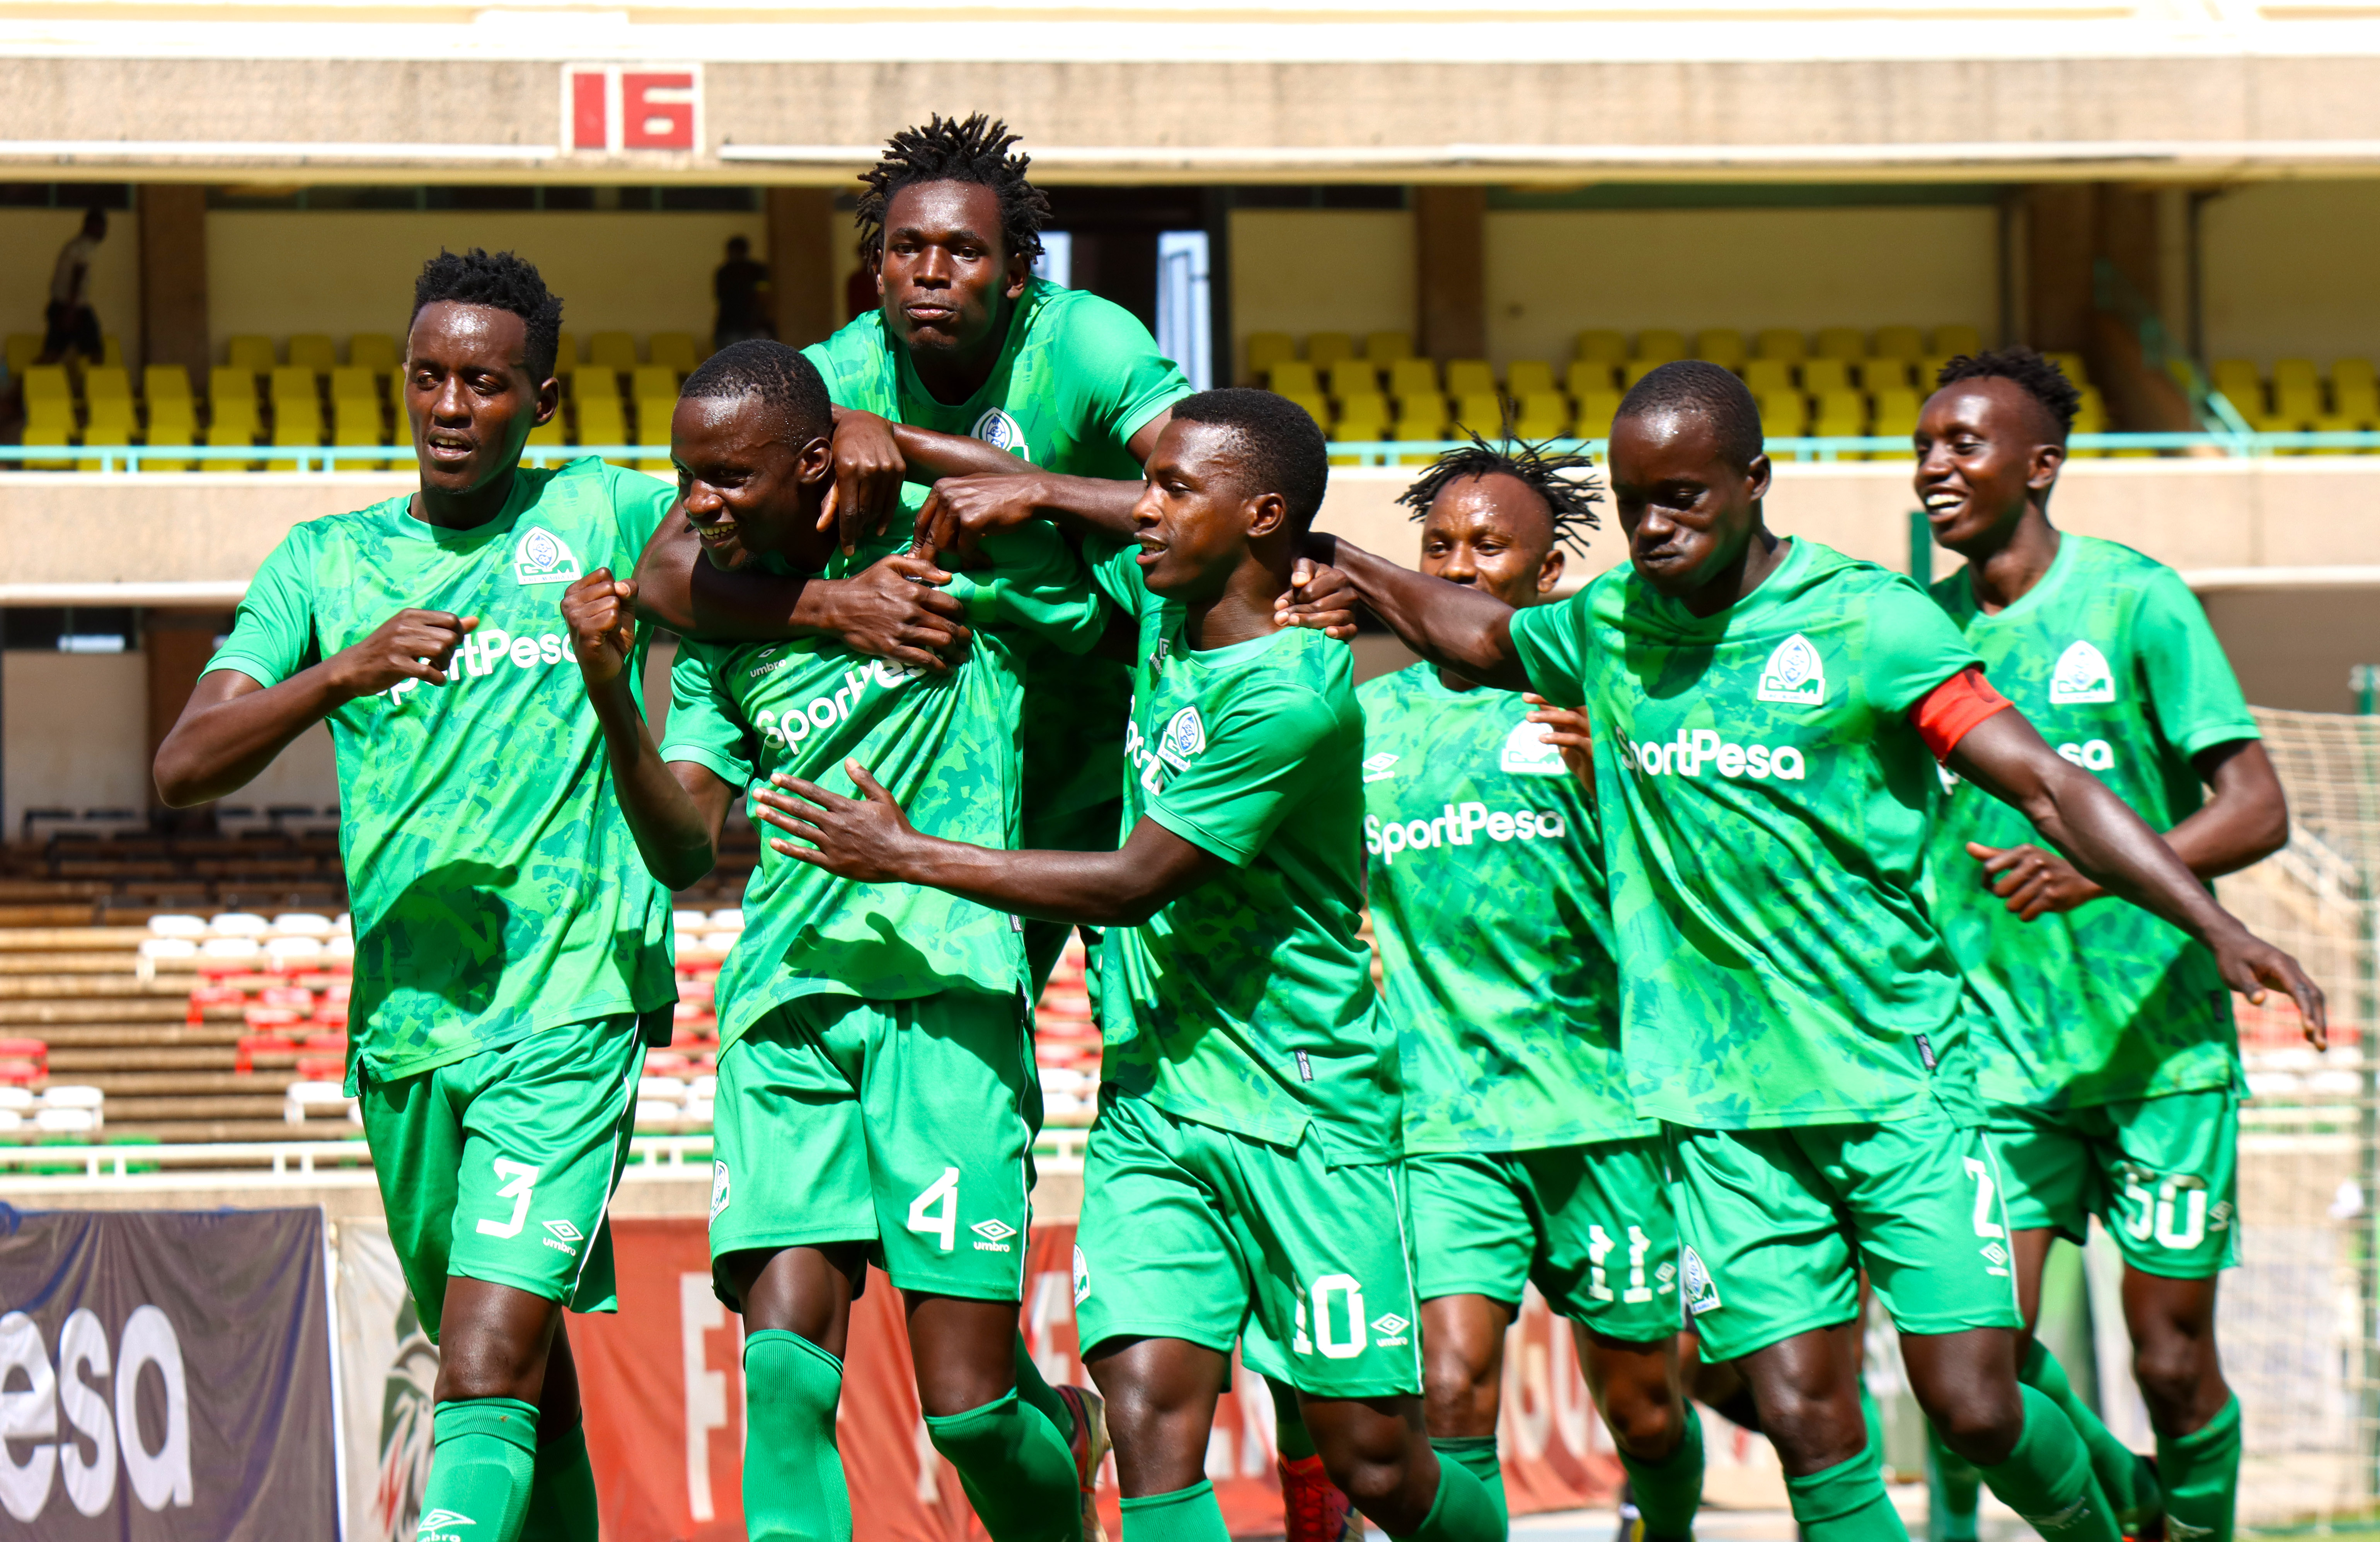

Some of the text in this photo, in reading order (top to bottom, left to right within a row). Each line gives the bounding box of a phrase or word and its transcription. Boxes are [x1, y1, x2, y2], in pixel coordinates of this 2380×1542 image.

[573, 73, 693, 148] 16
[750, 659, 786, 678] umbro
[1615, 726, 1805, 783] SportPesa
[1365, 802, 1565, 865] SportPesa
[476, 1158, 539, 1239] 3
[907, 1167, 959, 1251] 4
[1962, 1155, 2005, 1239] 2
[543, 1237, 576, 1256] umbro
[974, 1241, 1010, 1253] umbro
[1589, 1224, 1653, 1304] 11
[1293, 1271, 1367, 1359] 10
[1377, 1336, 1408, 1347] umbro
